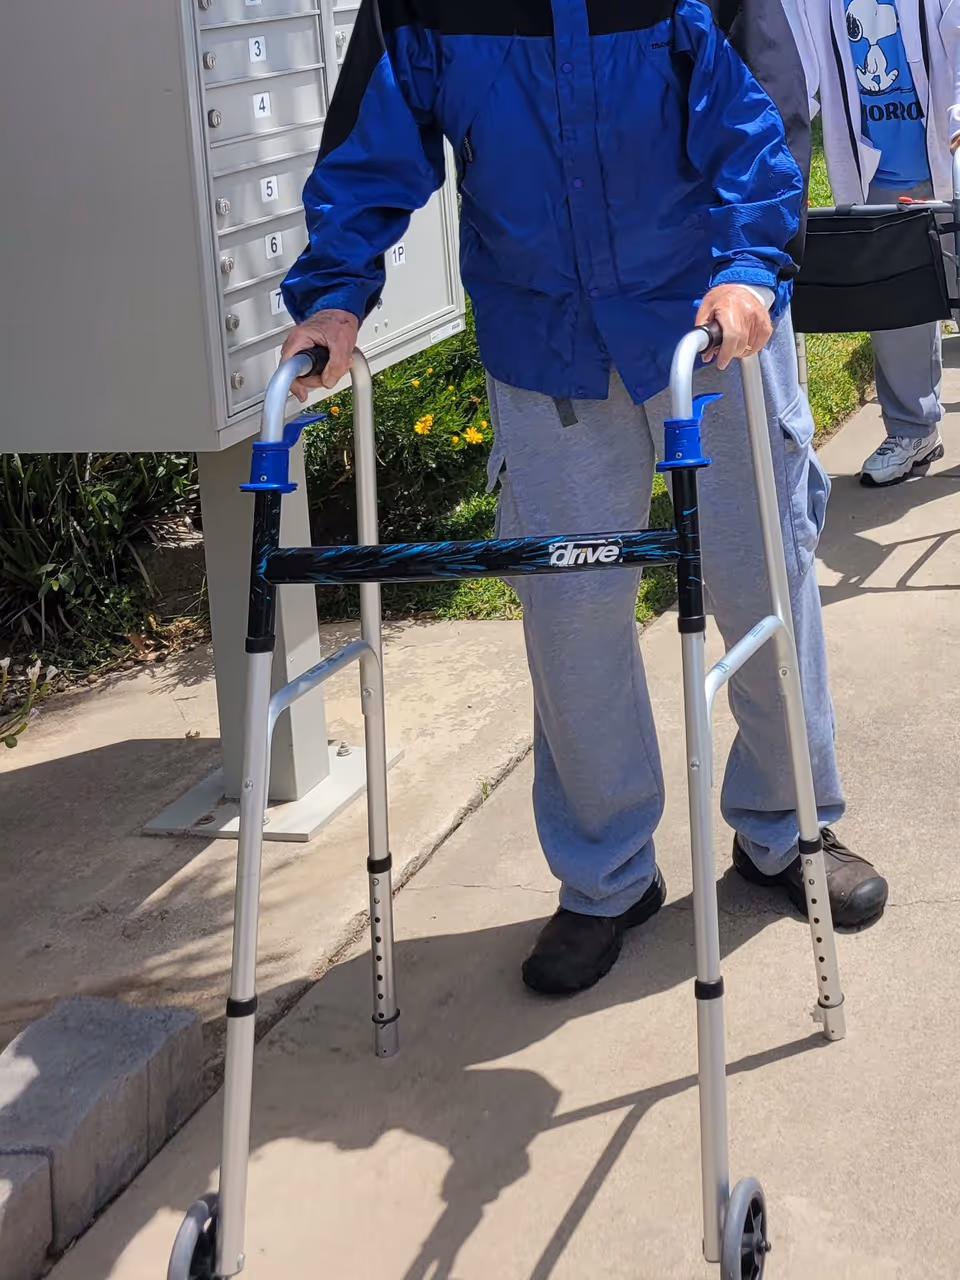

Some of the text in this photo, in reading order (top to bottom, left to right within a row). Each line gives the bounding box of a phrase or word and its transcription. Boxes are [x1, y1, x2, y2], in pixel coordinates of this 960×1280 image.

[253, 40, 262, 58] 3
[258, 96, 266, 113] 4
[265, 180, 273, 198] 5
[270, 236, 278, 255] 6
[393, 245, 404, 264] 1P
[275, 291, 282, 310] 7
[551, 542, 620, 566] drive
